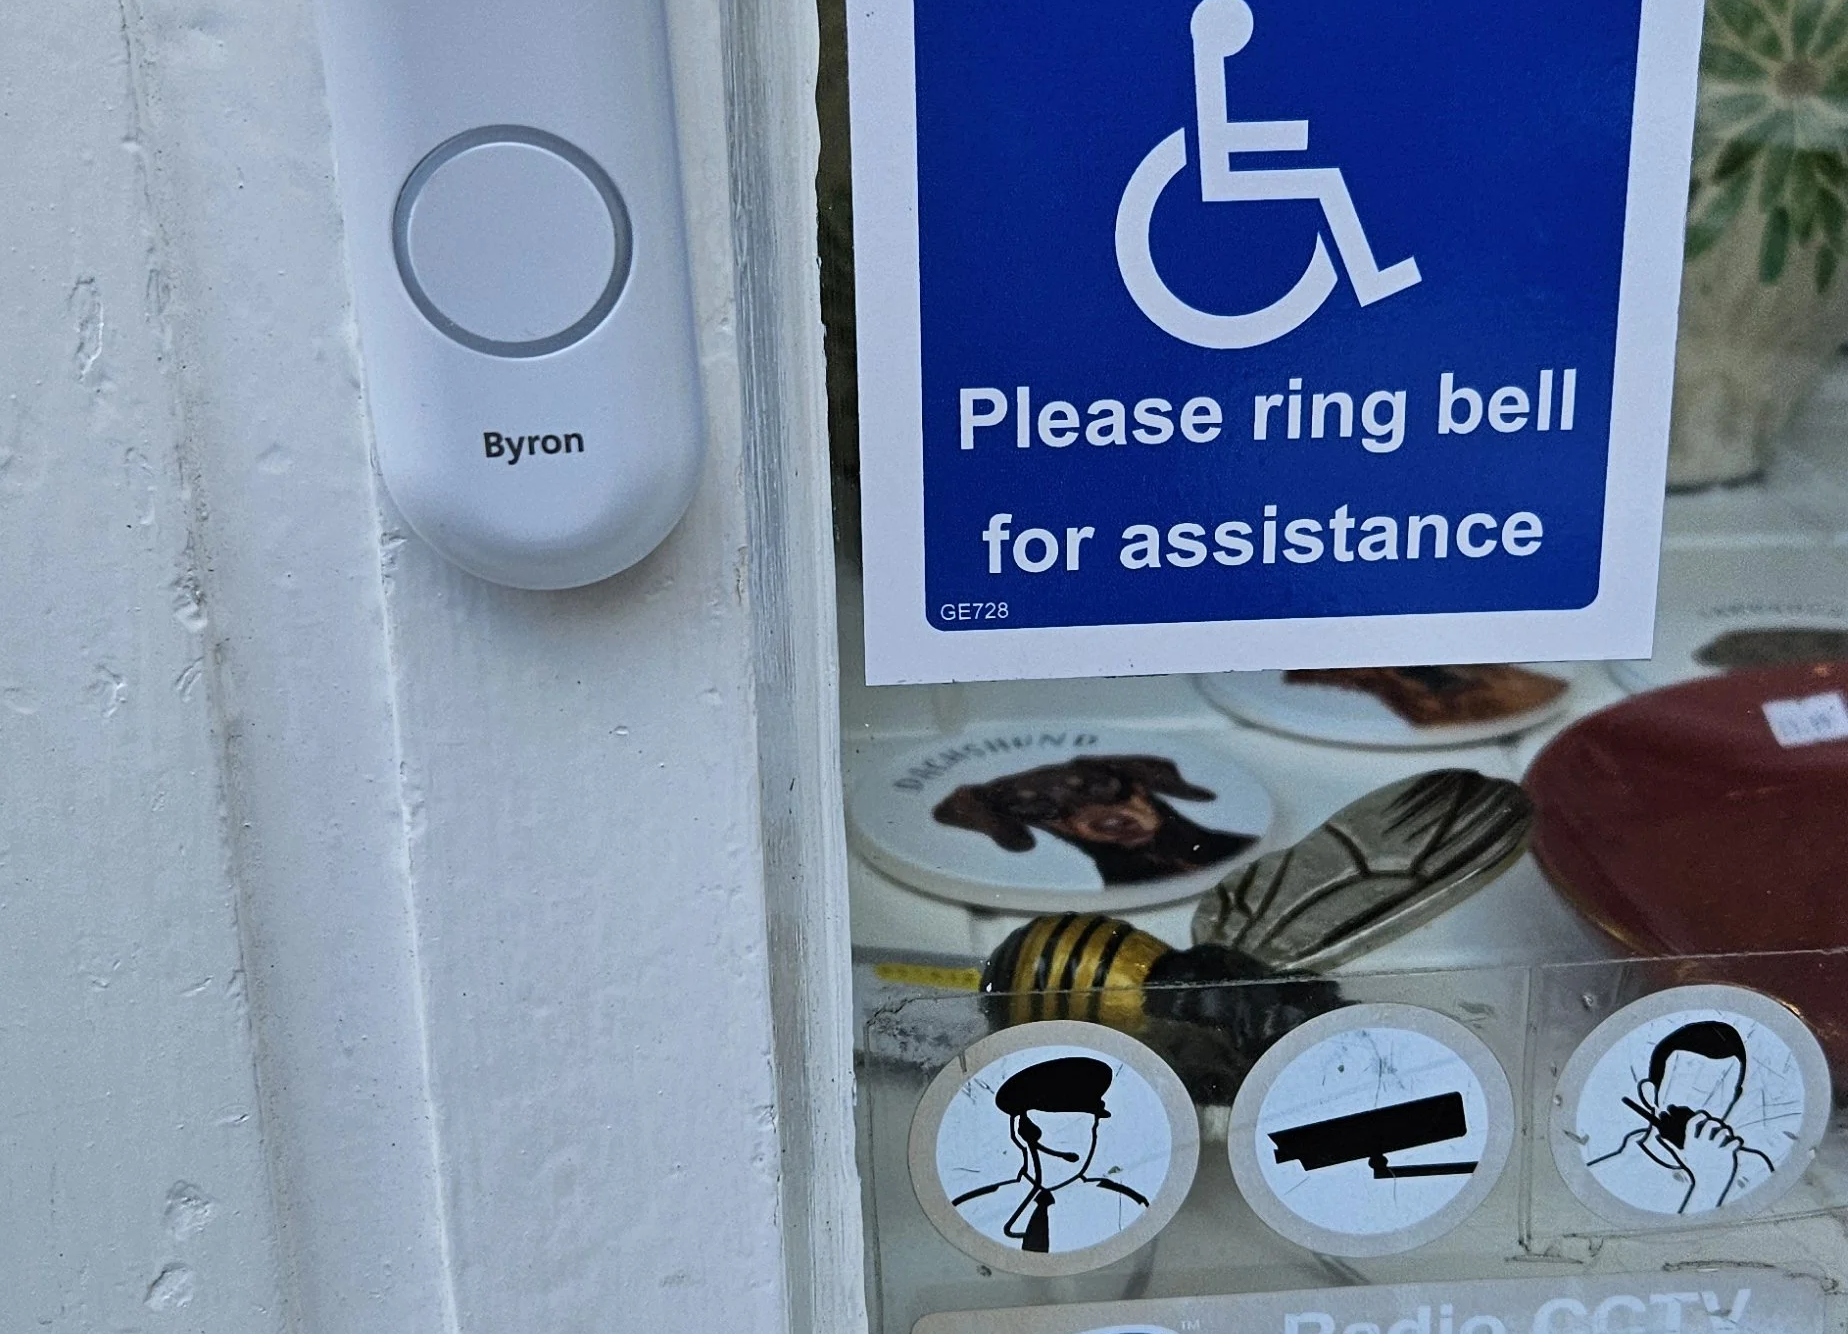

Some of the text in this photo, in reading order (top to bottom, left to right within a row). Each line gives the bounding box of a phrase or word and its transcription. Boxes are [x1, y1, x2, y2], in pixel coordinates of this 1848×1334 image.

[959, 368, 1577, 454] Please ring bell
[483, 431, 584, 466] Byron
[982, 503, 1544, 574] for assistance
[940, 601, 1009, 621] GE728
